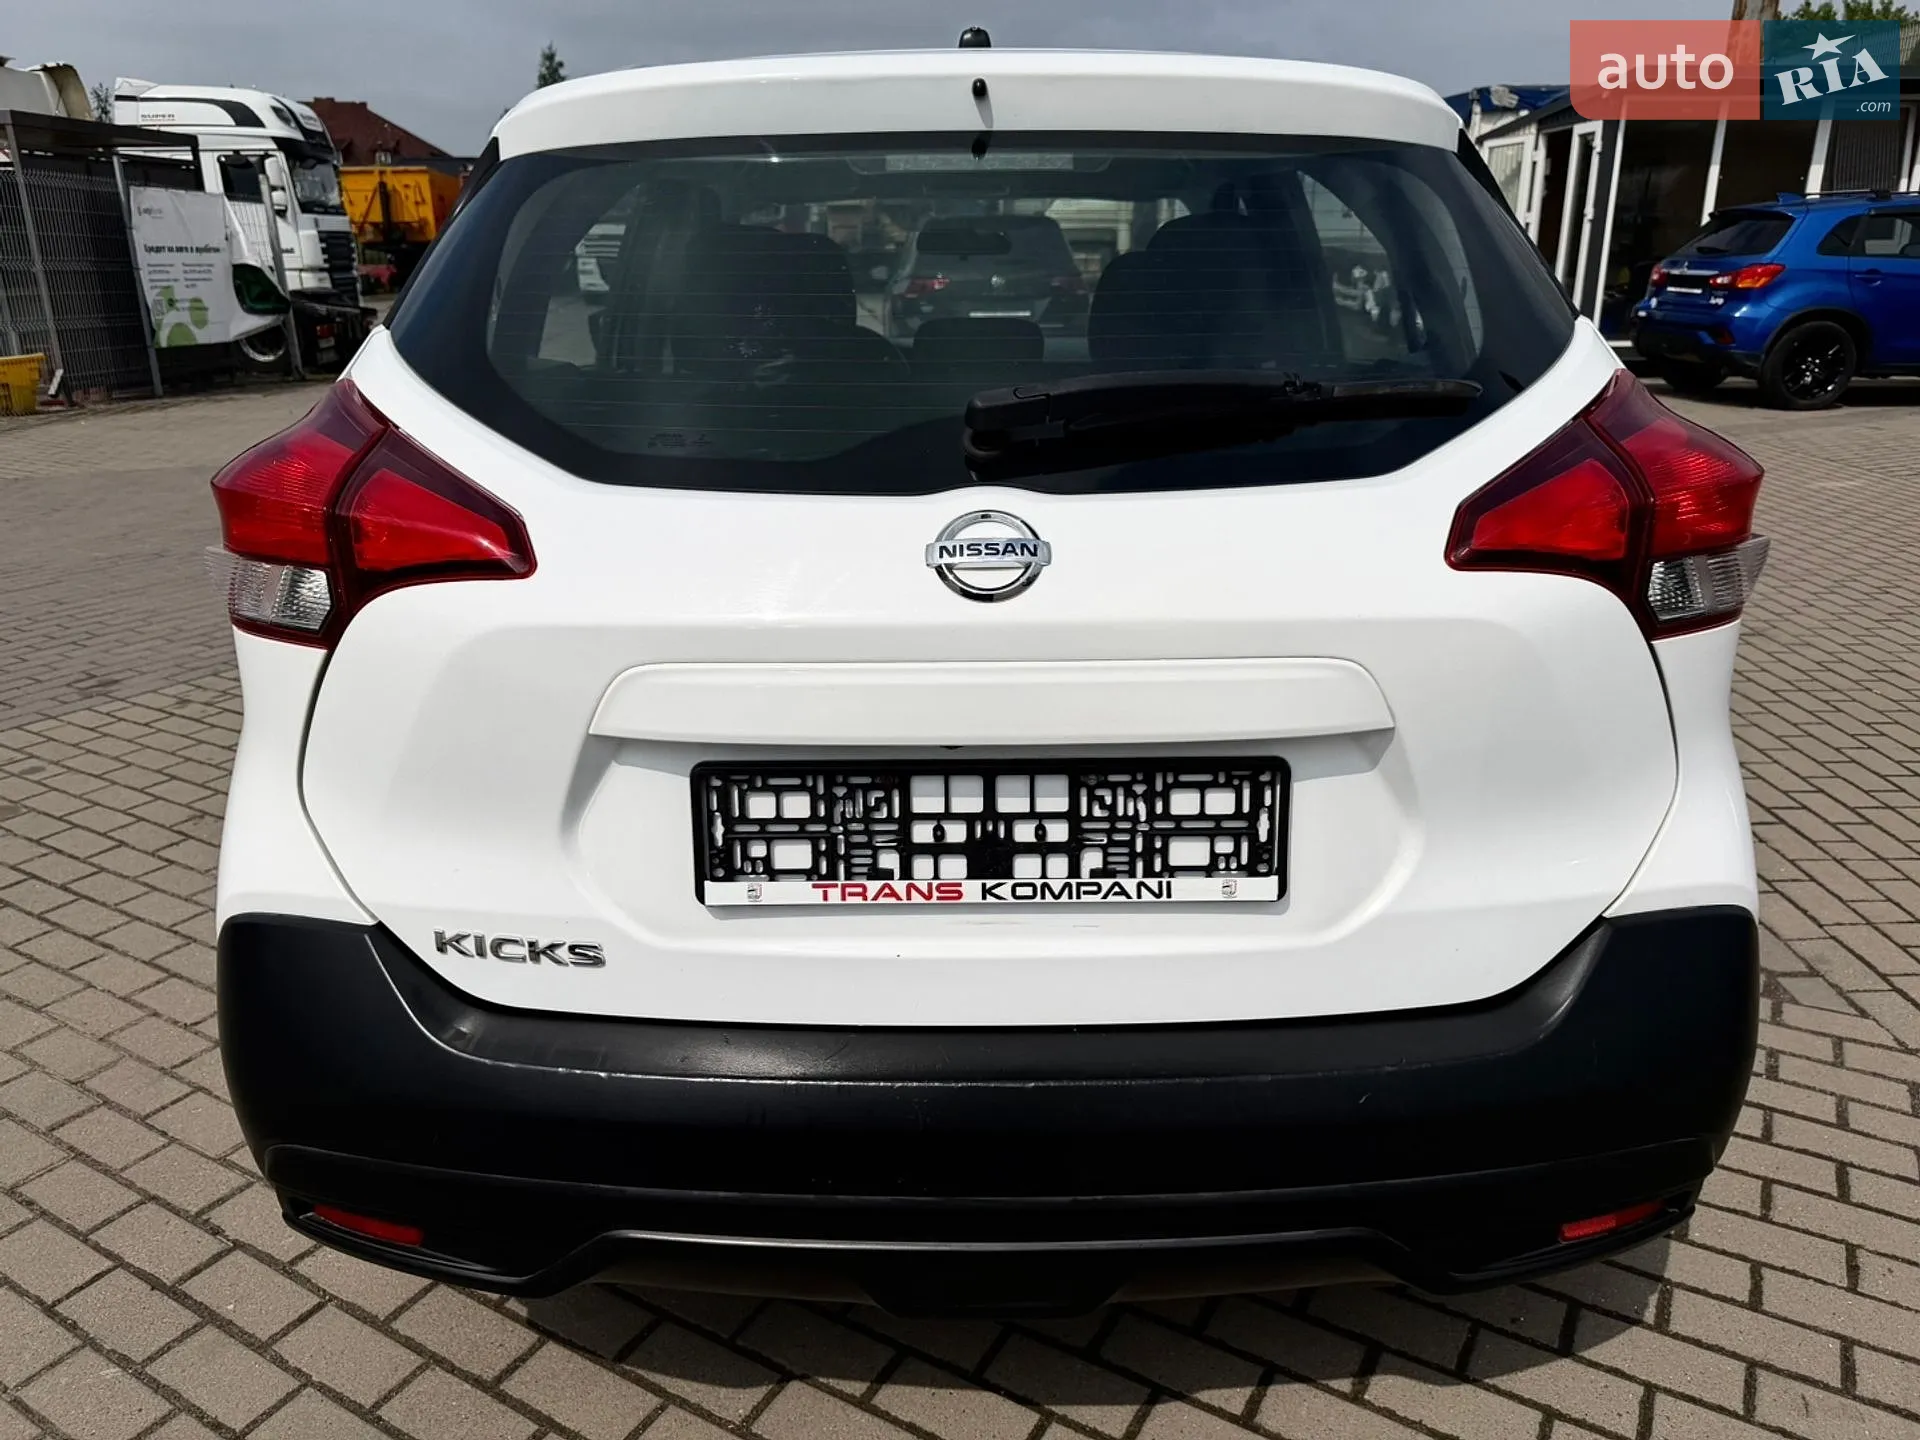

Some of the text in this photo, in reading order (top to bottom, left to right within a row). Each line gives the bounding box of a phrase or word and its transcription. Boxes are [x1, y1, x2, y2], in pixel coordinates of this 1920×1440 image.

[938, 542, 1039, 559] NISSAN
[811, 880, 1173, 902] TRANS KOMPANI
[434, 929, 607, 968] KICKS
